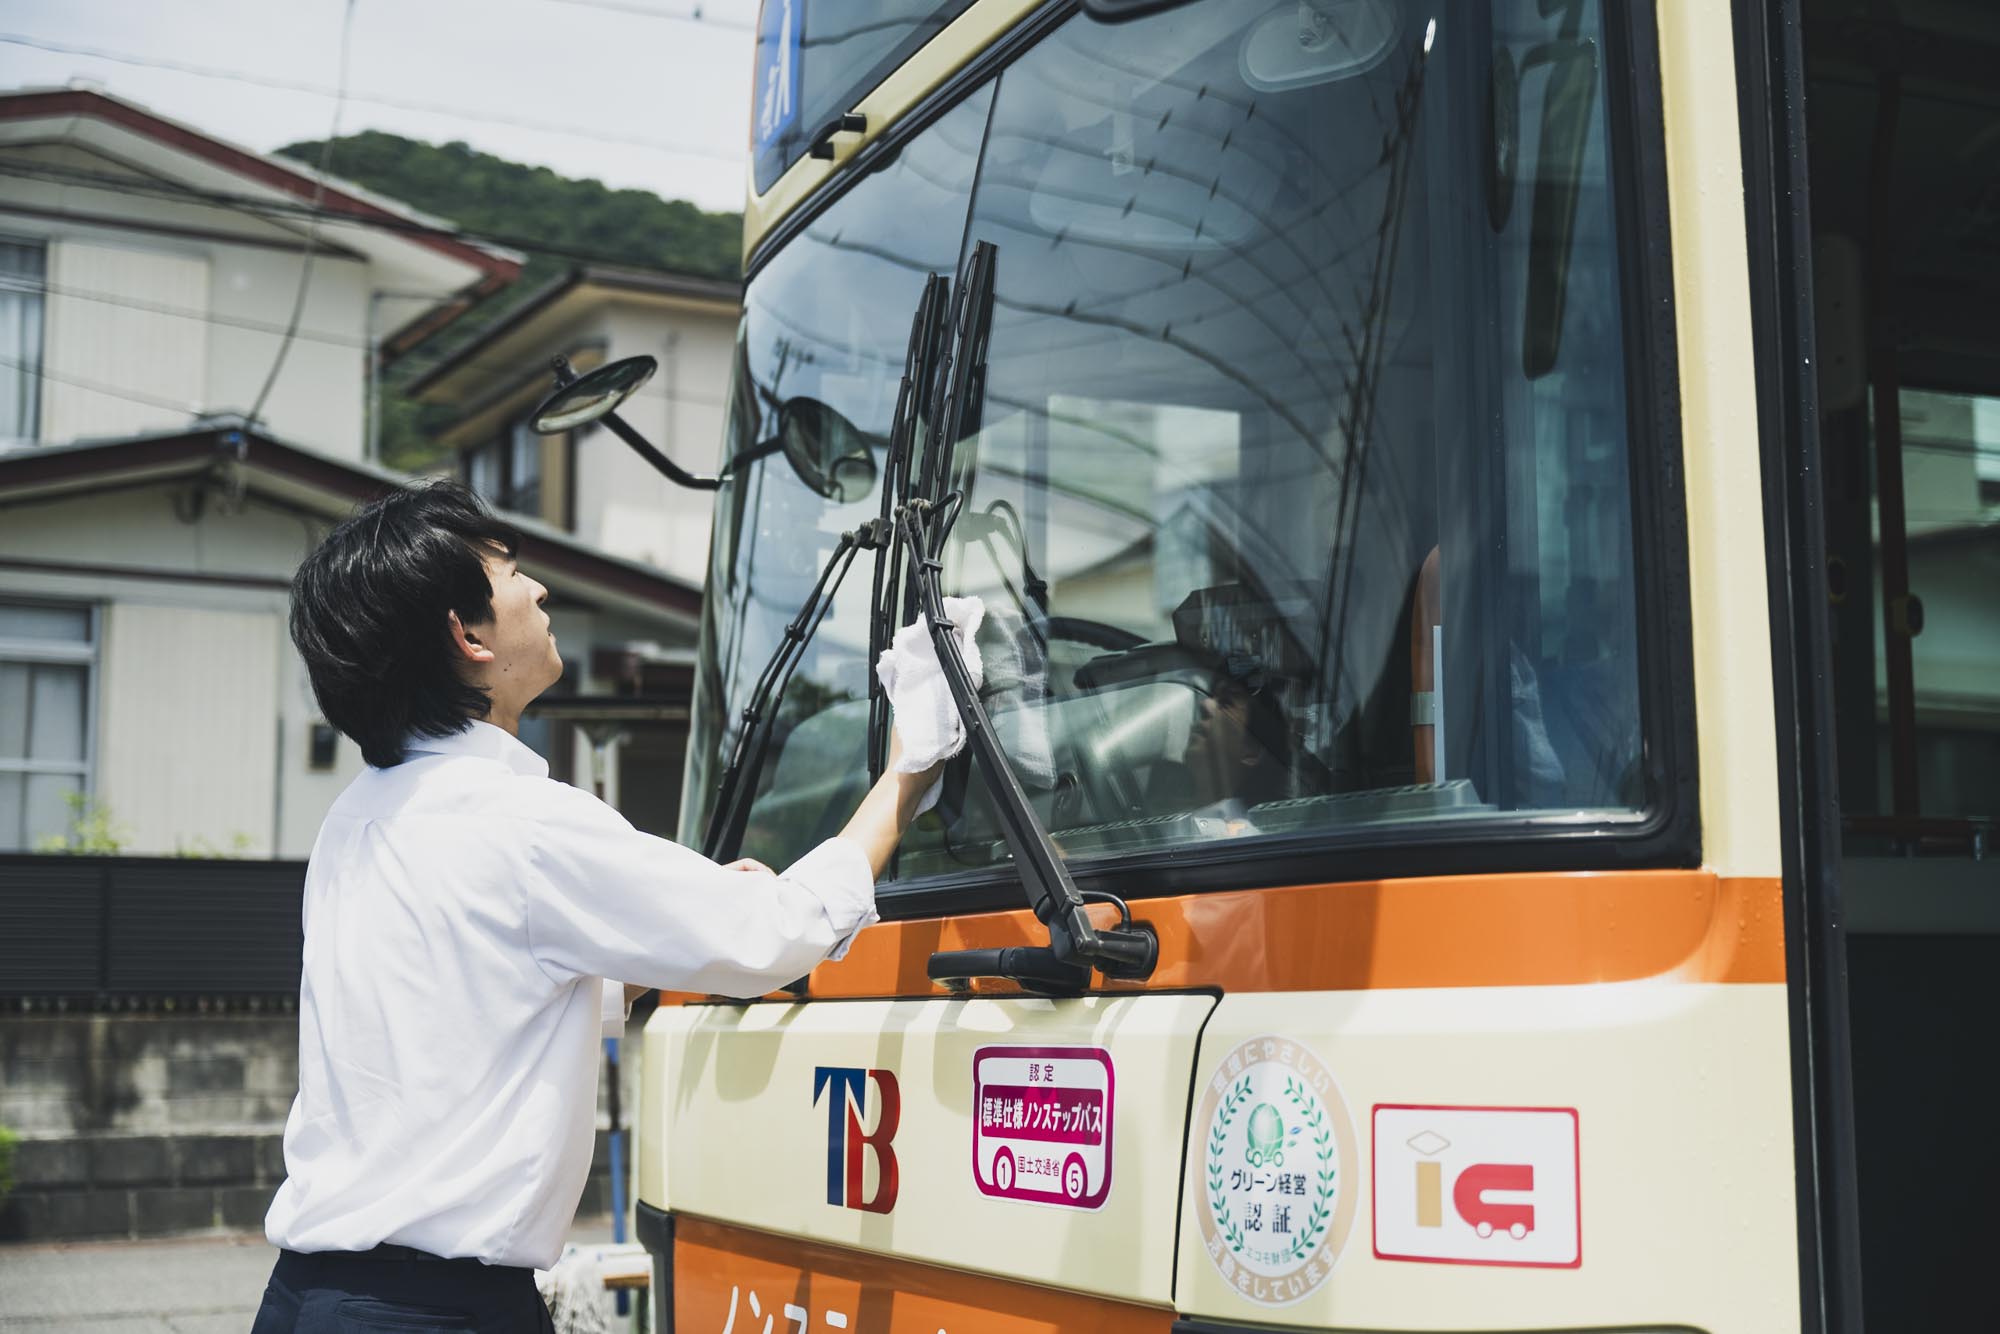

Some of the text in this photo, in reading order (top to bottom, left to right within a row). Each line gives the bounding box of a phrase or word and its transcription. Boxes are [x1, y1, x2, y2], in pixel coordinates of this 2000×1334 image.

[1029, 1063, 1054, 1082] 認定
[983, 1097, 1102, 1133] 標準仕様ノンステップバス
[1018, 1156, 1060, 1177] 国土交通省
[1231, 1169, 1307, 1196] グリーン経営
[1244, 1202, 1292, 1234] 認証
